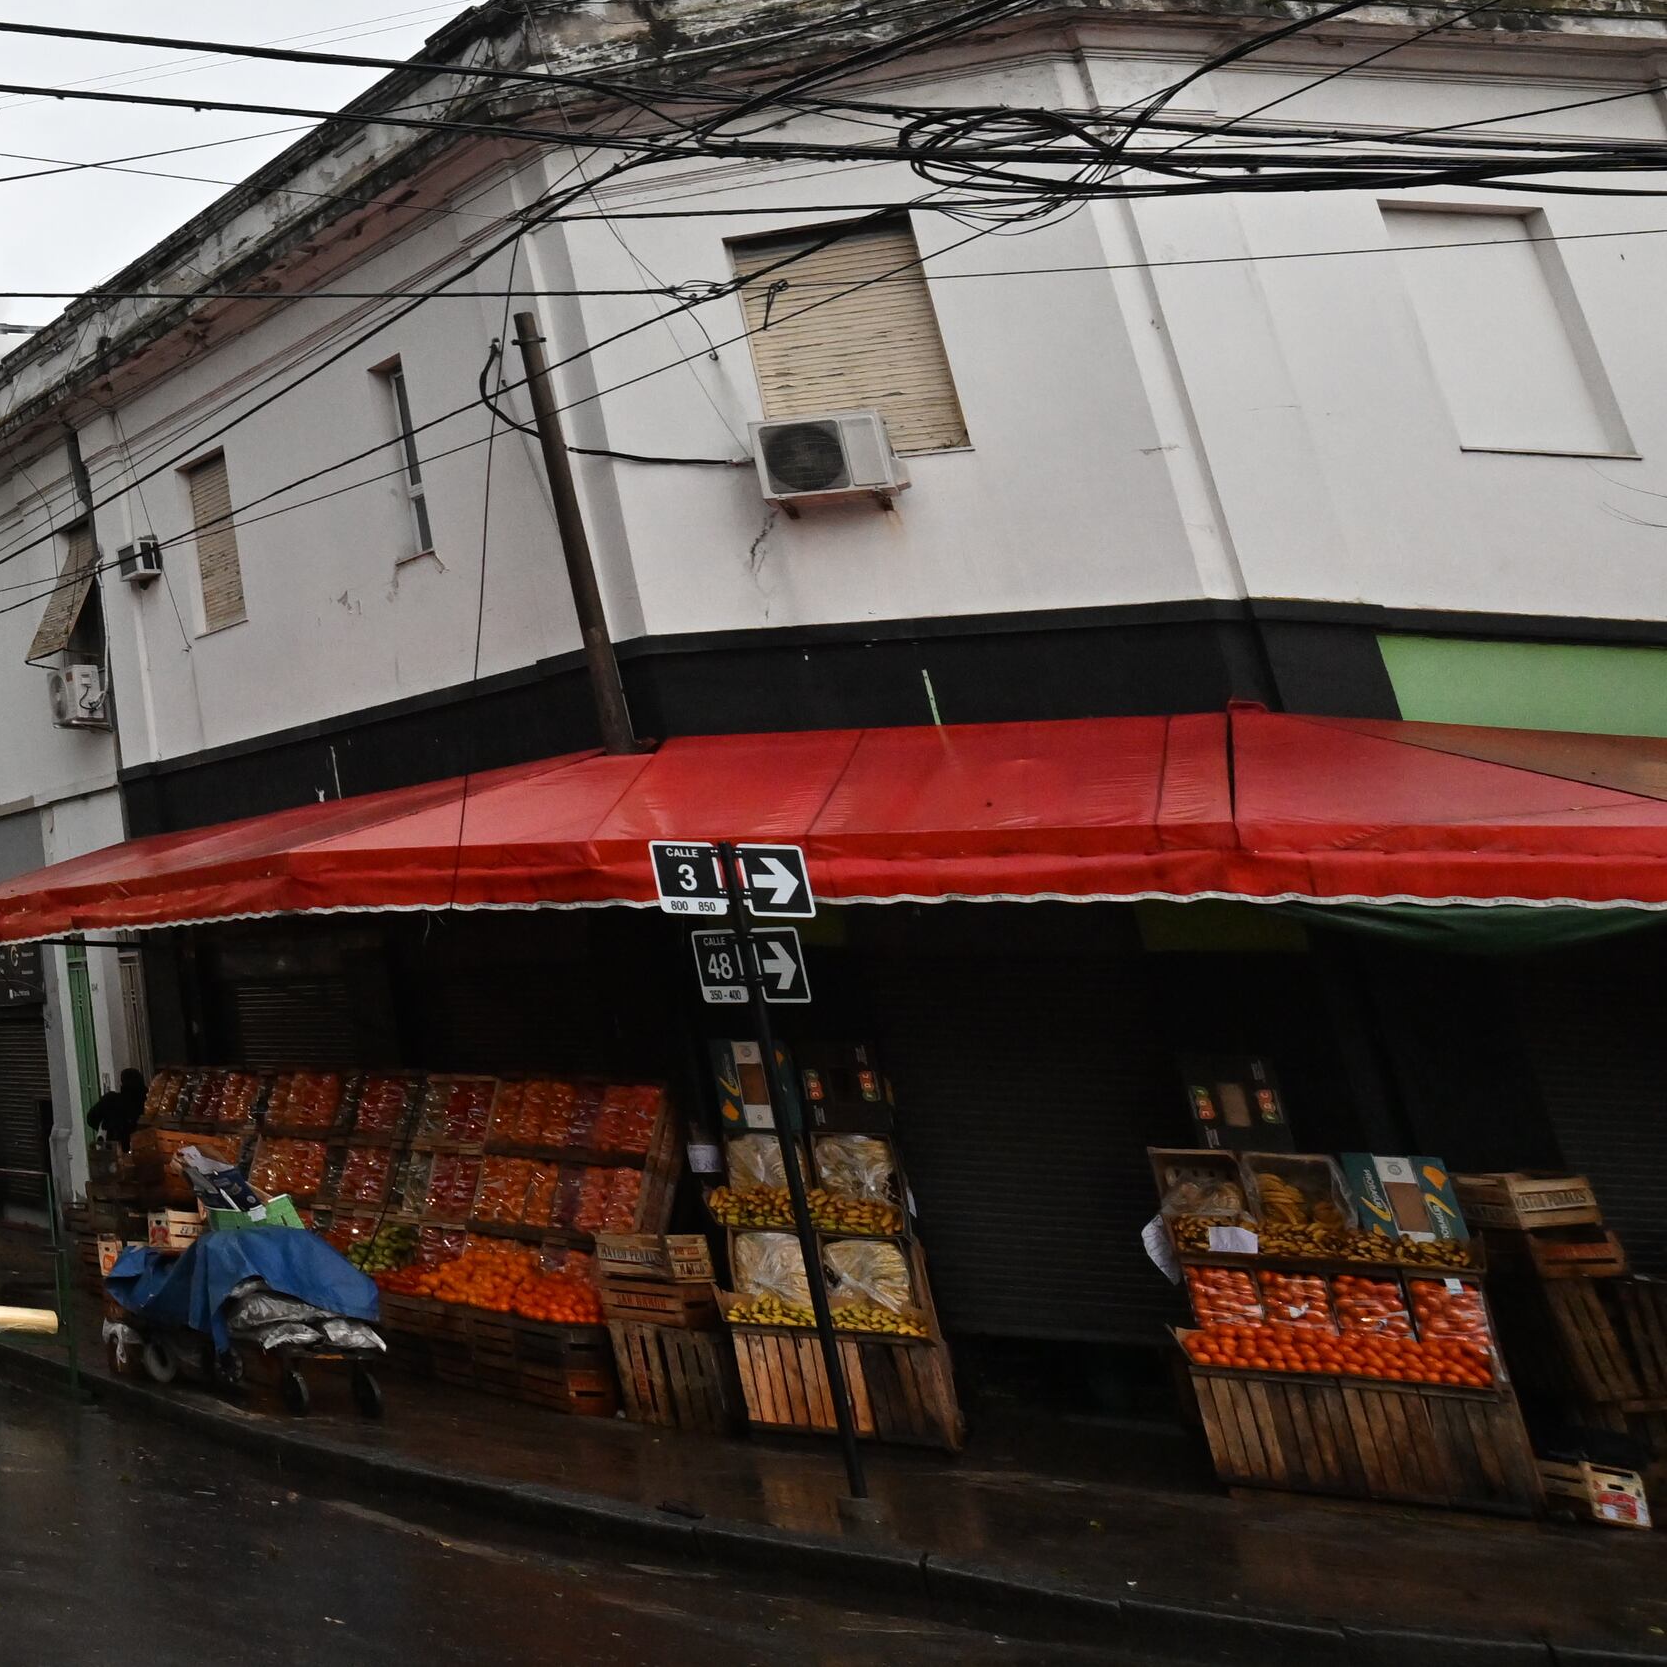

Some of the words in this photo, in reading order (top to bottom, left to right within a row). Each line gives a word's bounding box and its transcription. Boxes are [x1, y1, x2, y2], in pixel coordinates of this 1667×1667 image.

[665, 847, 699, 858] CALLE
[677, 864, 698, 891] 3
[670, 900, 688, 911] 800
[698, 901, 716, 912] 850
[703, 936, 727, 947] CALLE
[707, 952, 734, 980] 48
[709, 990, 722, 1000] 350
[729, 990, 742, 1000] 400
